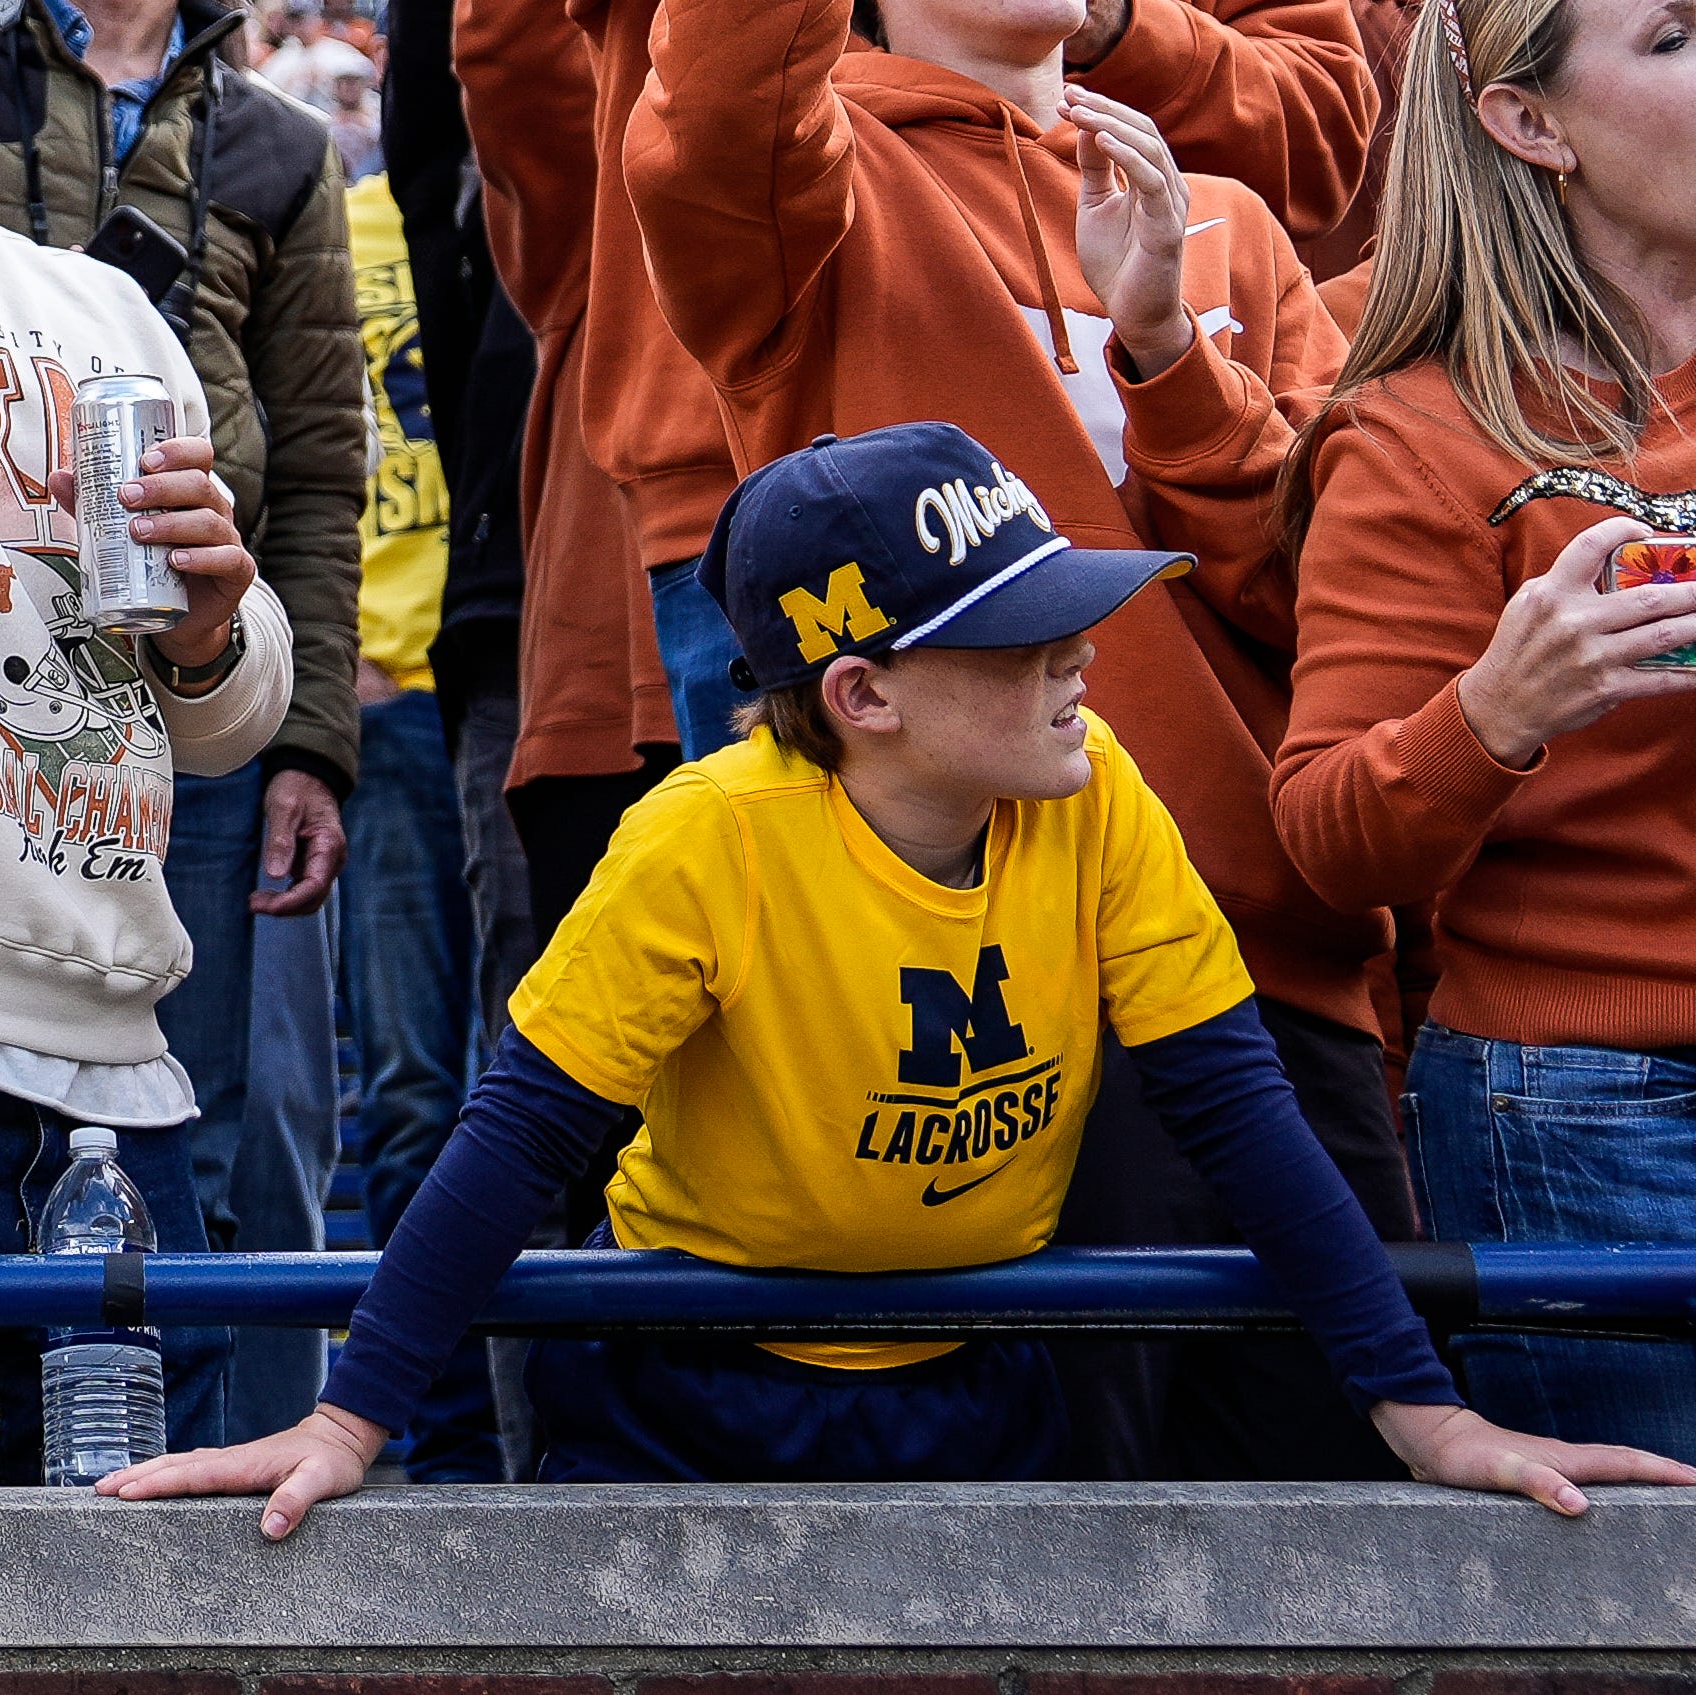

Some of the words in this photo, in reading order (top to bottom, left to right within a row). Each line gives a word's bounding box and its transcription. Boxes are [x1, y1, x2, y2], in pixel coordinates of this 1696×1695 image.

[778, 561, 891, 665] M
[897, 943, 1029, 1088] M
[854, 1068, 1063, 1167] LACROSSE
